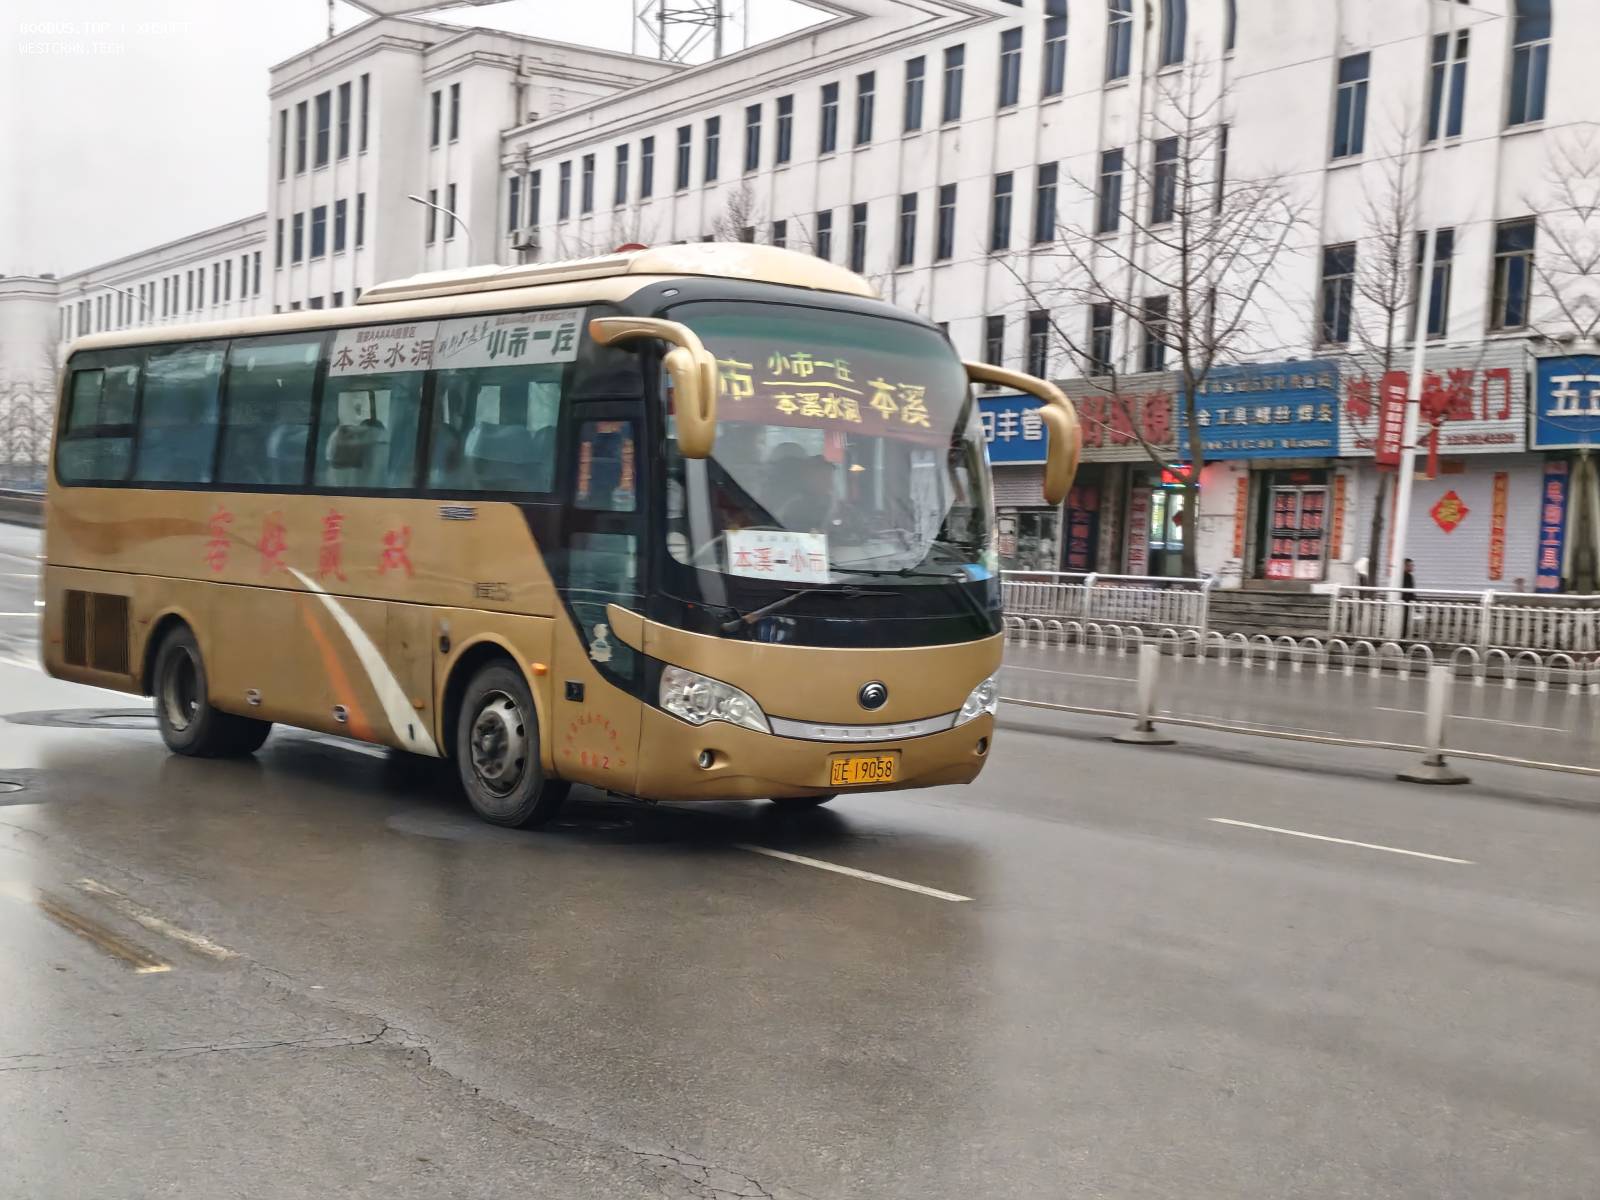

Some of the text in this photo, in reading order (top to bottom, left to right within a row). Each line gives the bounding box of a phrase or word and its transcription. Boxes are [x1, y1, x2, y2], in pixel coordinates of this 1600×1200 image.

[331, 340, 434, 372] 本溪水洞
[486, 322, 577, 360] 小市一庄
[774, 391, 863, 424] 本溪水洞
[866, 376, 931, 428] 本溪
